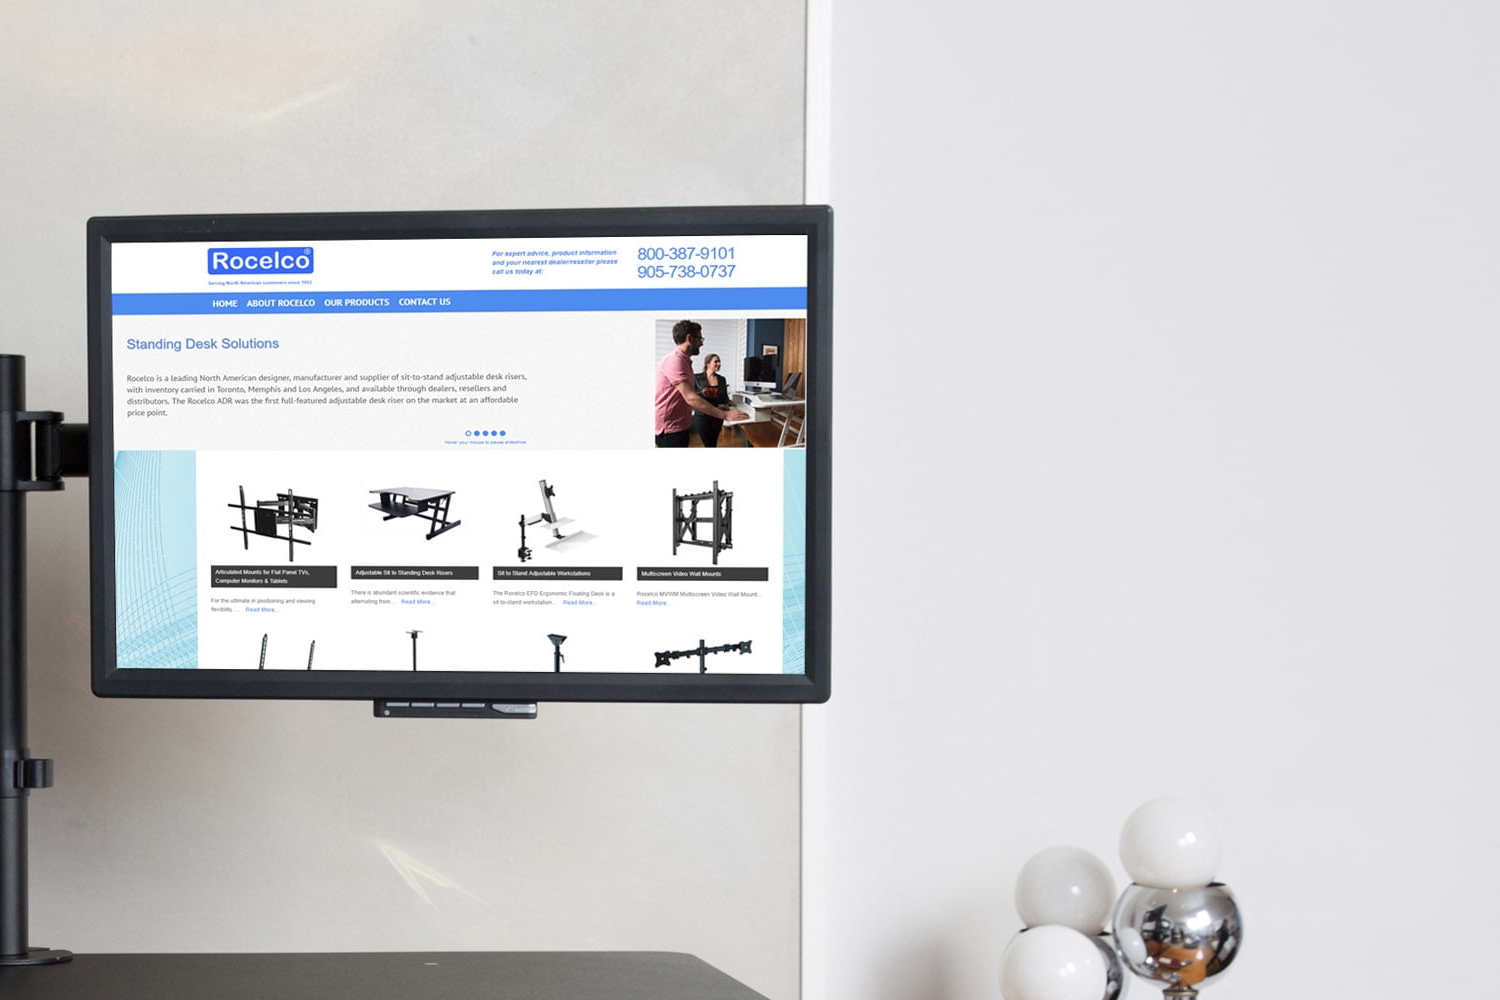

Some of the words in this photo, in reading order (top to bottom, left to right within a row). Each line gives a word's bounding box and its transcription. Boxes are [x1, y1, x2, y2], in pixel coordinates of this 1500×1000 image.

[637, 246, 734, 260] 800-387-9101
[211, 251, 310, 270] Rocelco
[637, 265, 735, 278] 905-738-0737
[212, 299, 238, 307] HOME
[246, 299, 276, 307] ABOUT
[276, 299, 315, 307] ROCELCO
[344, 298, 390, 306] PRODUCTS
[126, 338, 181, 352] Standing
[185, 338, 218, 349] Desk
[221, 337, 279, 349] Solutions
[170, 375, 198, 383] leading
[258, 374, 291, 383] designer,
[359, 373, 390, 381] supplier
[445, 373, 484, 381] adjustable
[504, 372, 527, 380] risers,
[144, 386, 179, 394] inventory
[217, 385, 246, 393] Toronto,
[247, 385, 281, 394] Memphis
[312, 385, 344, 394] Angeles,
[396, 385, 426, 393] through
[328, 396, 367, 405] adjustable
[126, 409, 145, 417] price
[146, 409, 167, 417] point.
